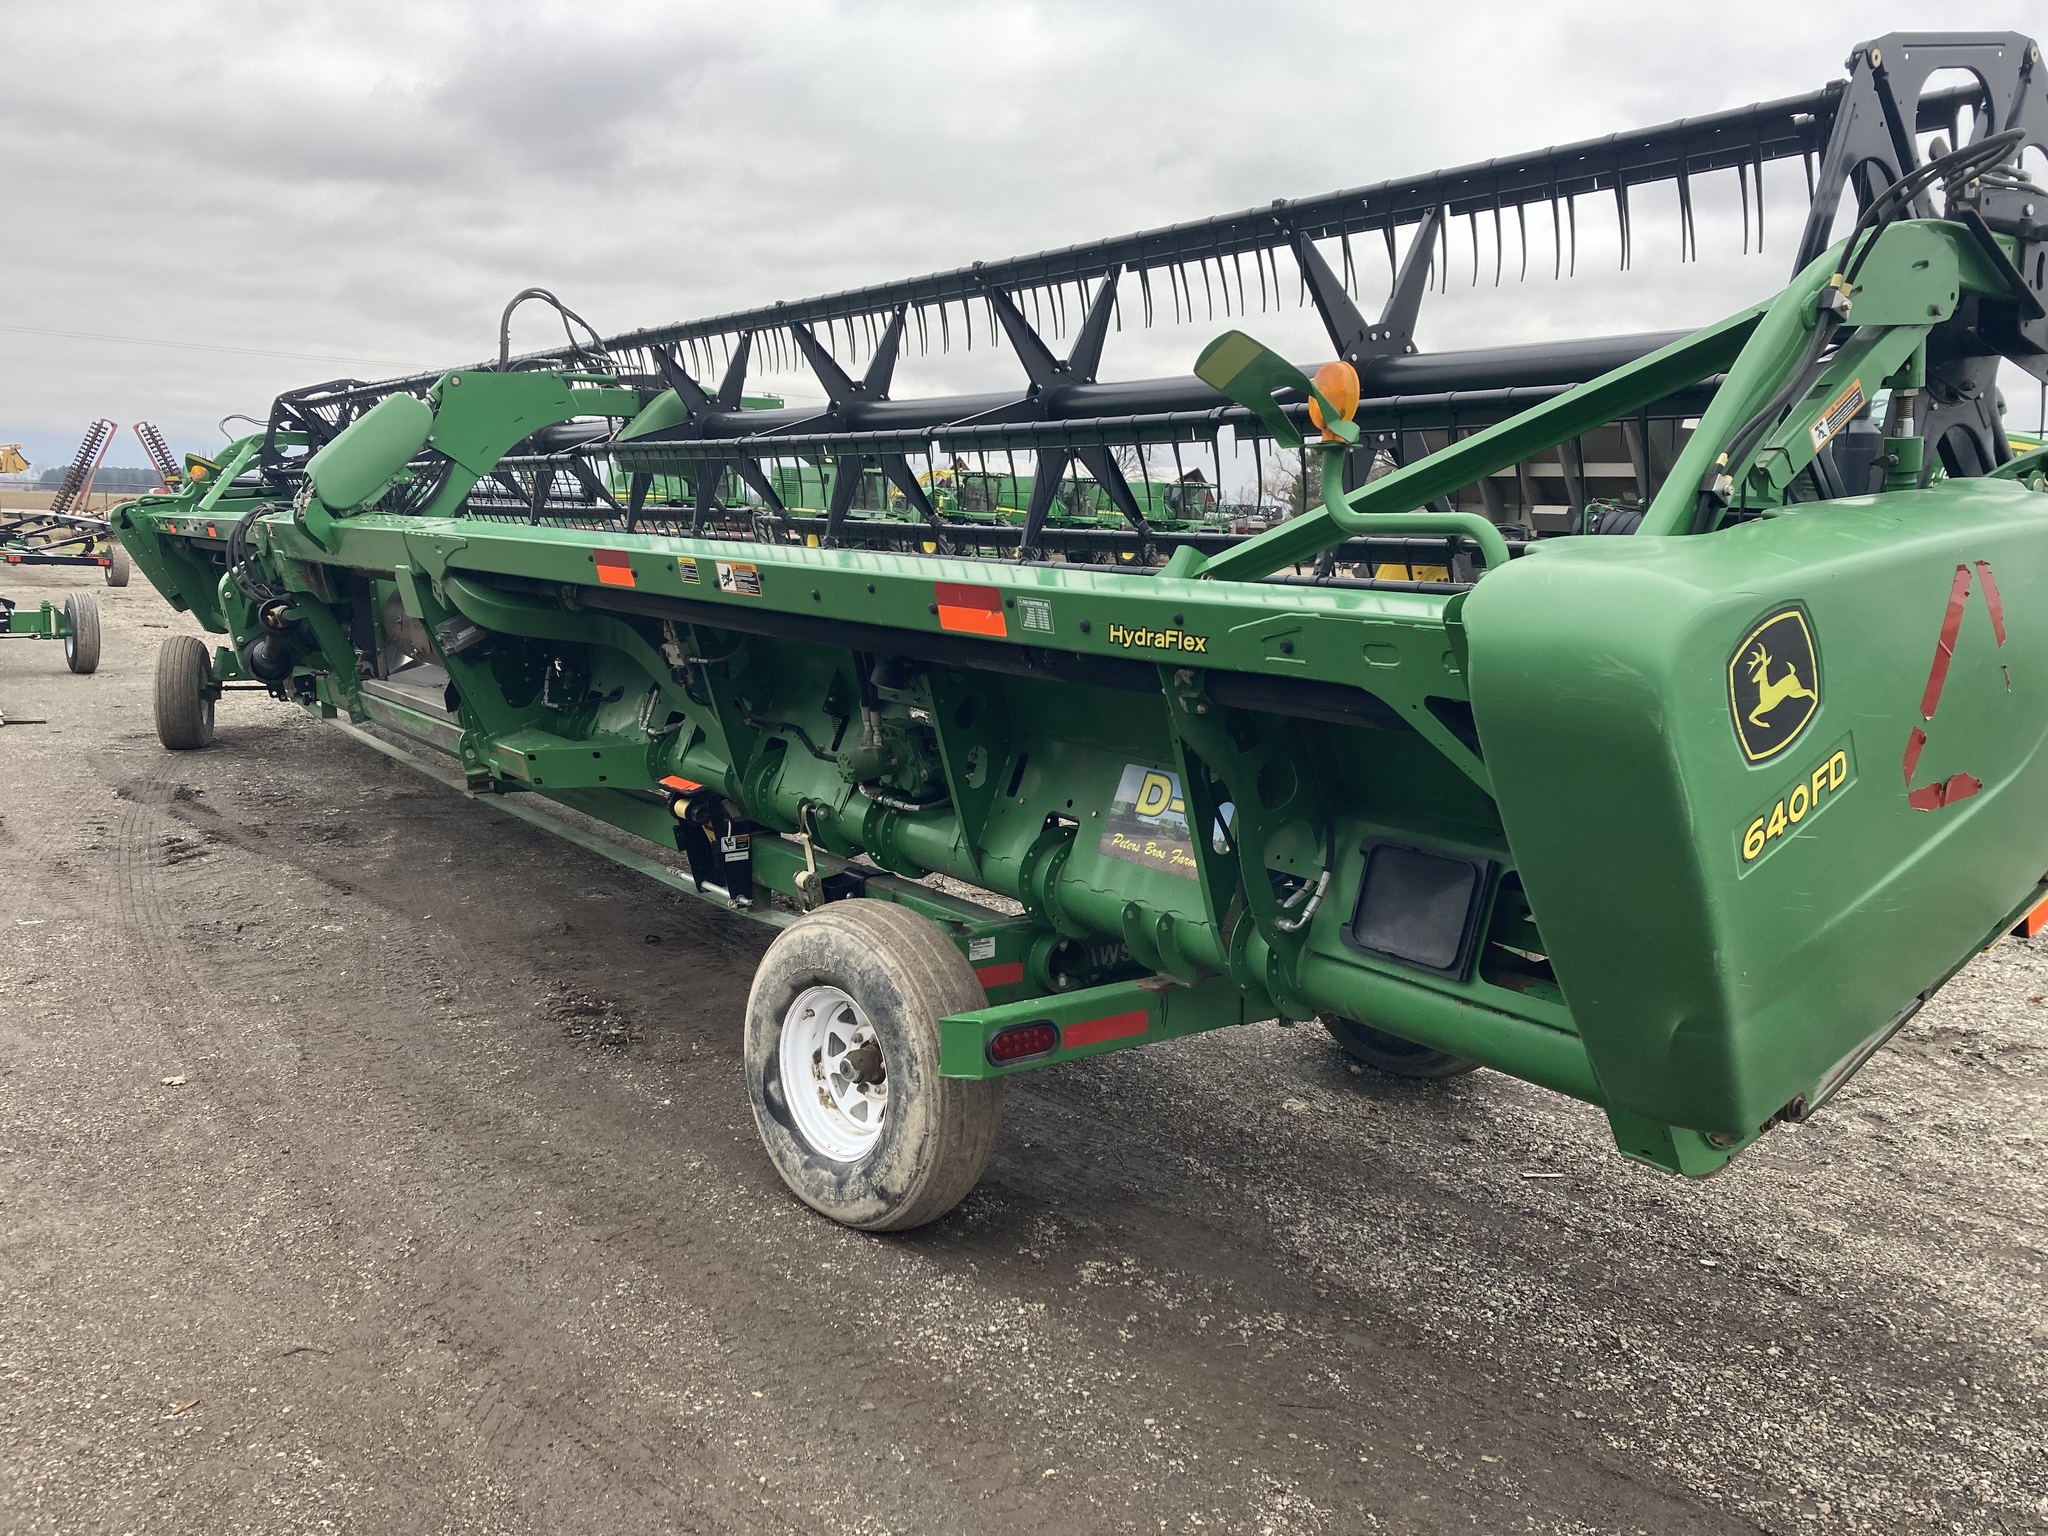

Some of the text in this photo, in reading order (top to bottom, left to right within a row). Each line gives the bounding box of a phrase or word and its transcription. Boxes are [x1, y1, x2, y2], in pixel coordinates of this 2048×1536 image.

[1109, 624, 1208, 653] HydraFlex
[1135, 771, 1187, 818] D-
[1742, 750, 1847, 861] 640FD
[1111, 833, 1197, 868] Peters Bros Farm
[779, 950, 841, 982] TITAN
